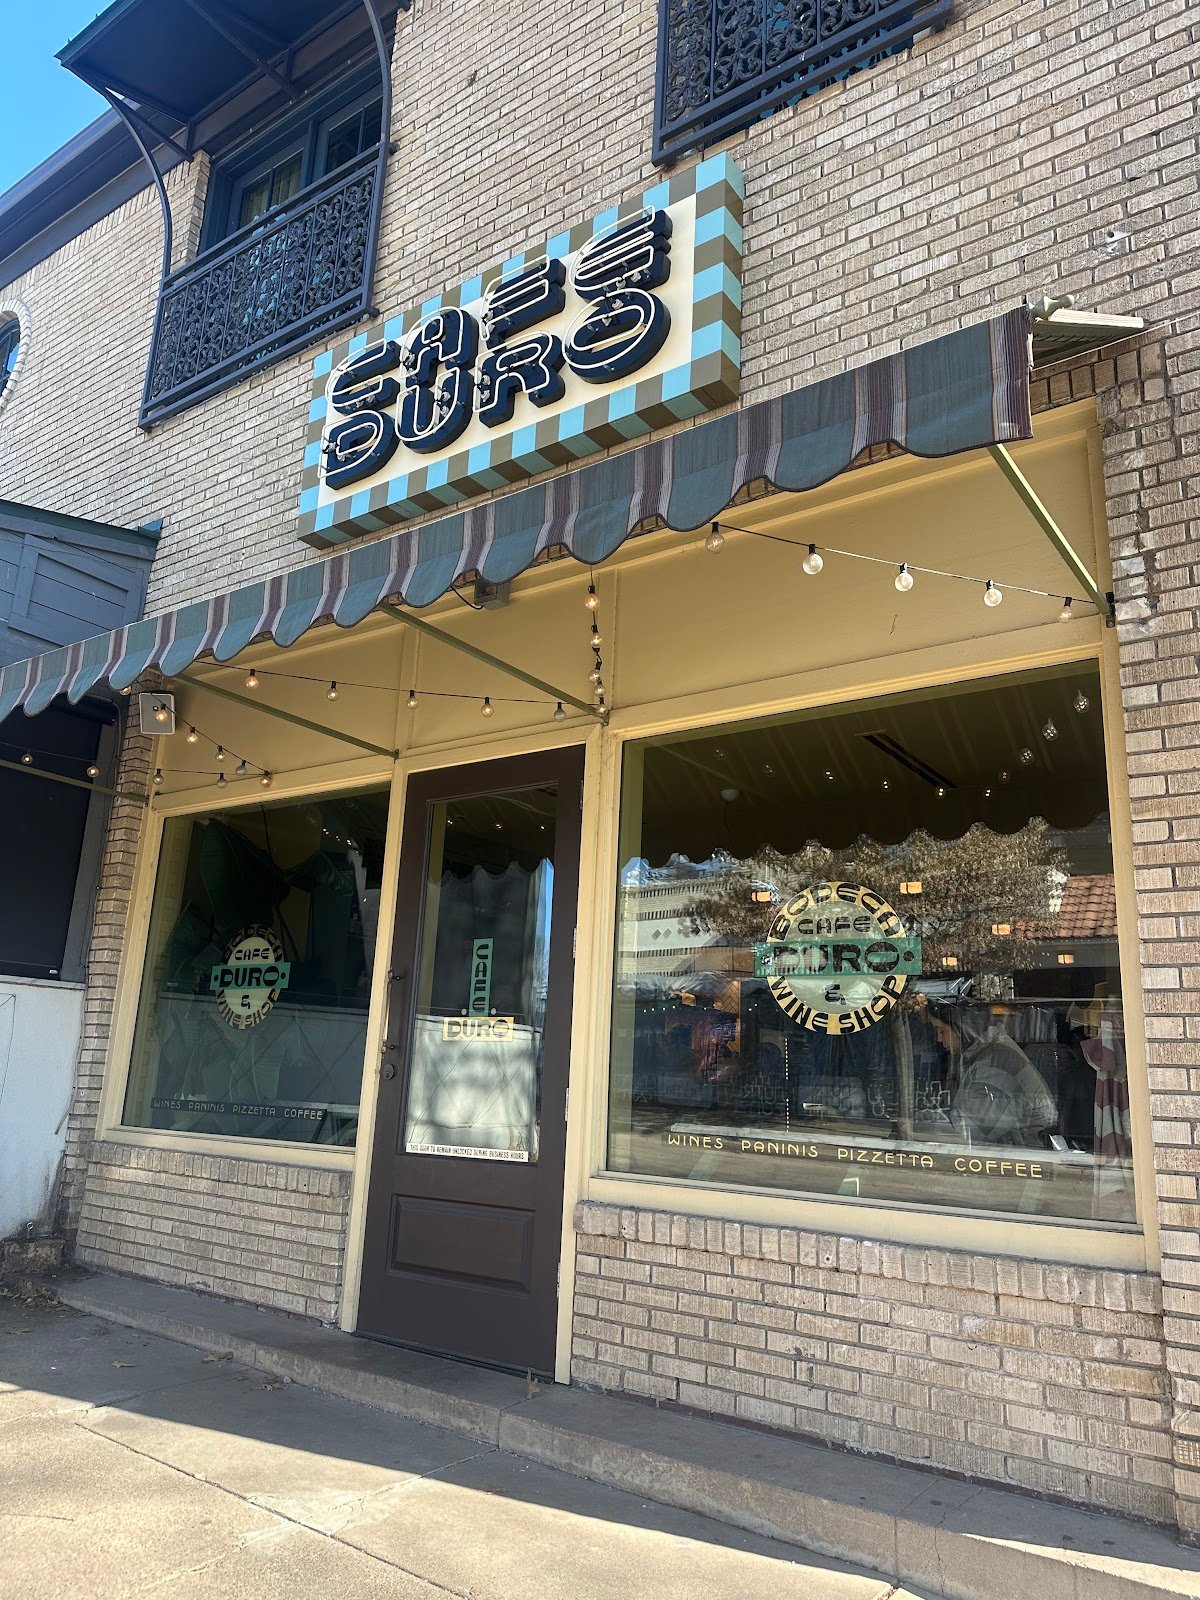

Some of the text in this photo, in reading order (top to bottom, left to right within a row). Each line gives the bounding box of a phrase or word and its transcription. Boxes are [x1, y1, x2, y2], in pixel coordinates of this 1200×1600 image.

[326, 205, 673, 416] CAFE
[317, 288, 672, 490] DURO
[769, 882, 901, 941] BODEGA
[797, 915, 871, 935] CAFE
[234, 948, 270, 961] CAFE
[773, 941, 900, 973] DURO
[218, 965, 280, 988] DURO
[472, 943, 489, 1013] CAFE
[216, 988, 281, 1030] WINE SHOP
[770, 975, 901, 1035] WINE SHOP
[446, 1018, 510, 1039] DURO
[153, 1100, 323, 1120] WINES PANINIS PIZZETTA COFFEE
[452, 1147, 472, 1155] UNLOCKED
[489, 1150, 509, 1159] BUSINESS
[510, 1151, 525, 1160] HOURS
[667, 1133, 1044, 1179] WINES PANINIS PIZZETTA COFFEE
